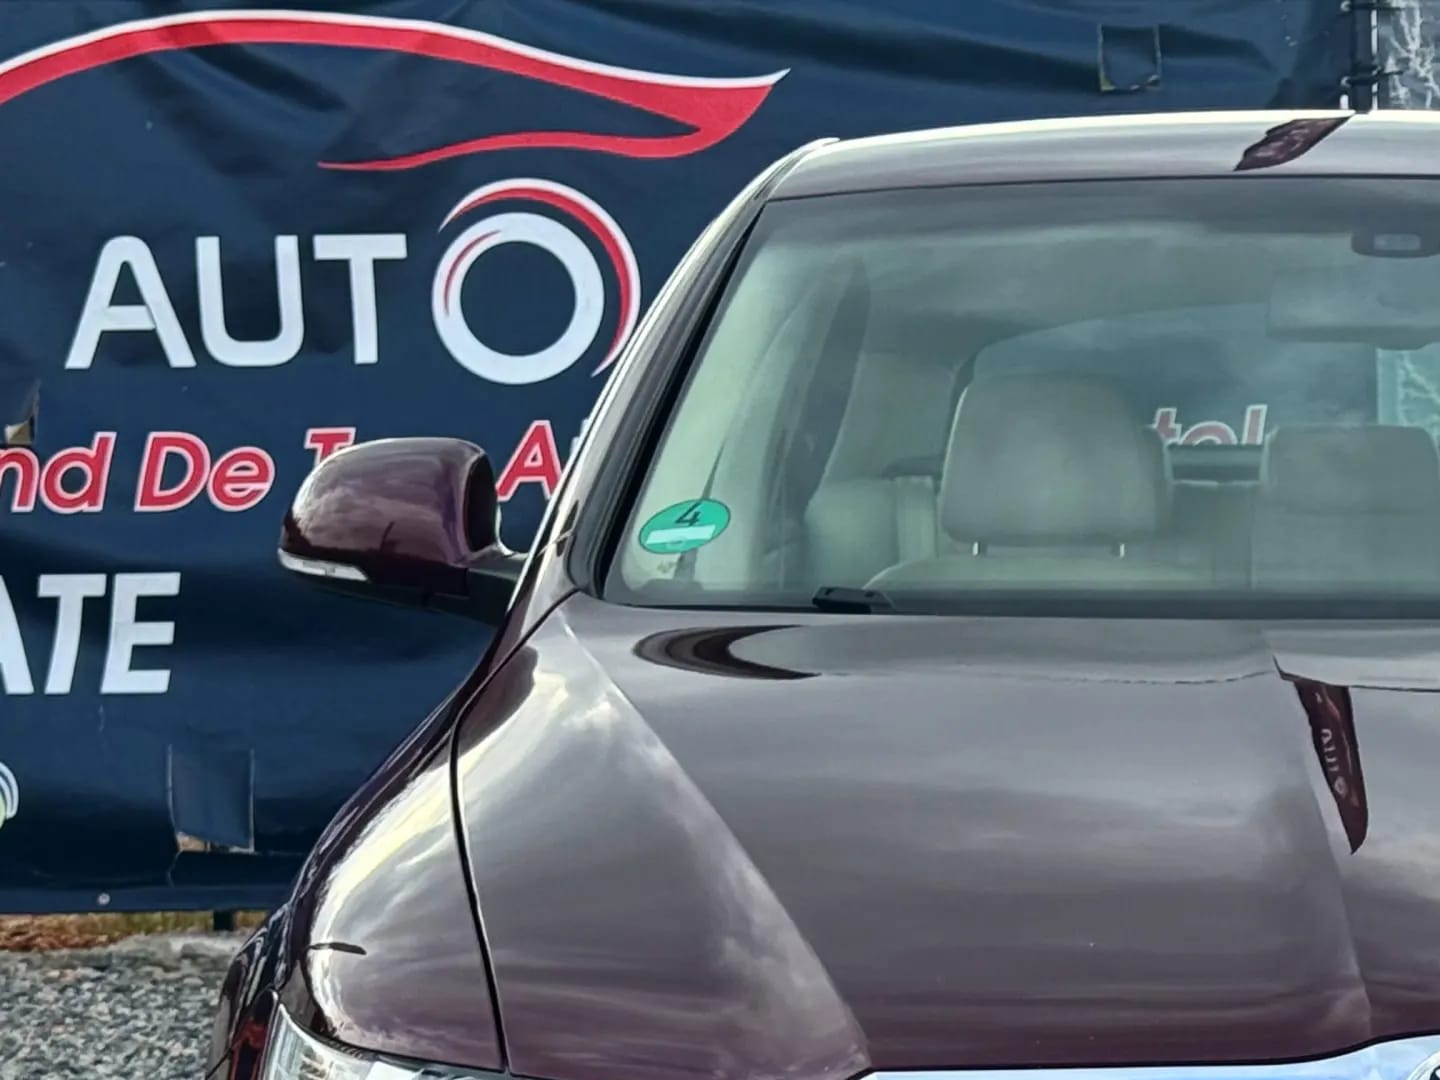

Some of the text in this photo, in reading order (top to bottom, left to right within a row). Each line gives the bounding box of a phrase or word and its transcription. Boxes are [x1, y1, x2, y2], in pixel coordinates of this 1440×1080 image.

[65, 212, 604, 385] AUTO
[134, 431, 275, 512] De
[675, 501, 703, 527] 4
